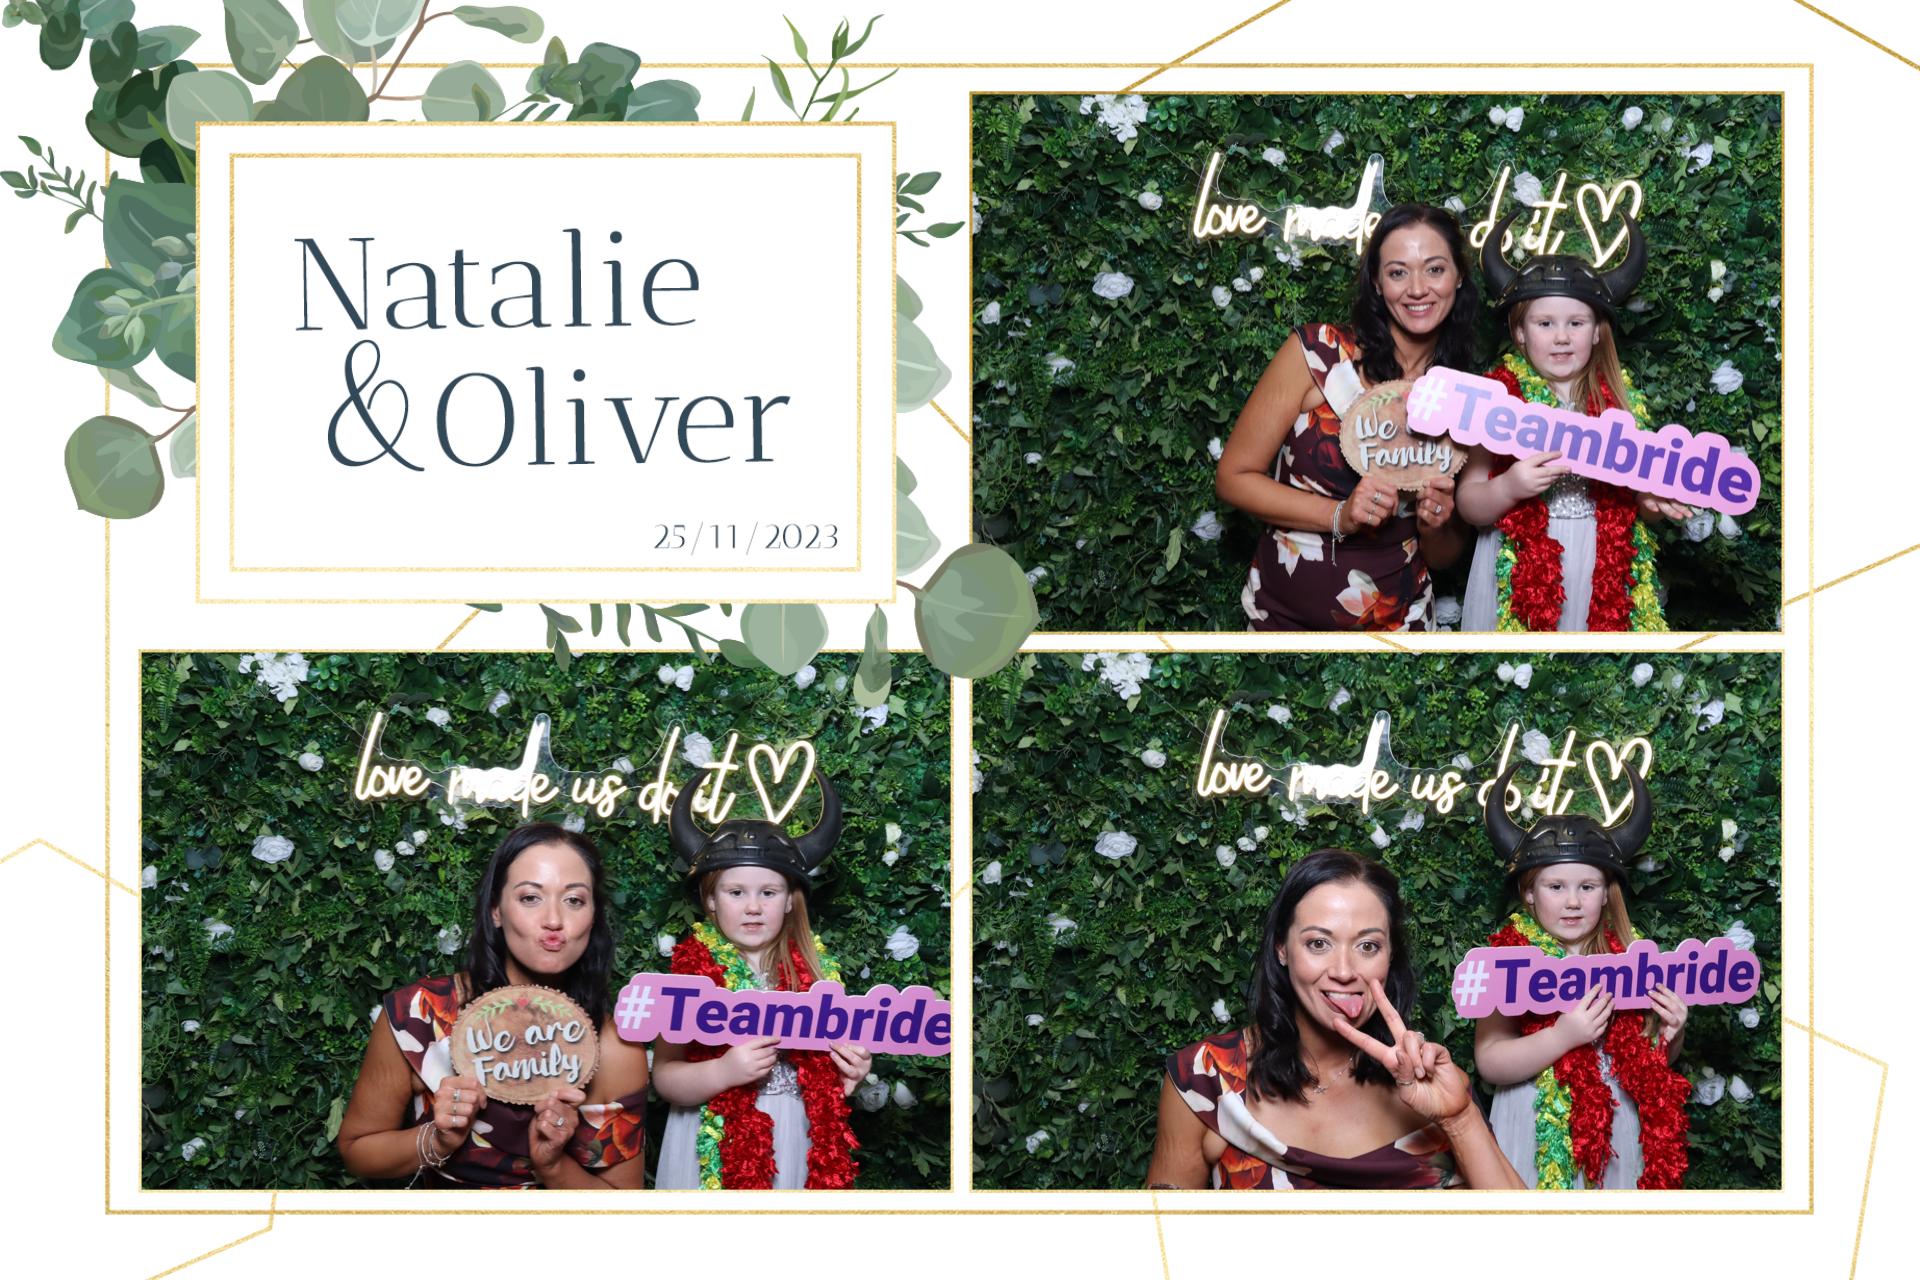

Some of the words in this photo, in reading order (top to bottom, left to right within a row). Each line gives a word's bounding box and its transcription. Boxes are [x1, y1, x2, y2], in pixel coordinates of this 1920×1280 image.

[1193, 152, 1267, 238] love
[1524, 172, 1568, 256] it
[1355, 407, 1398, 440] We
[1410, 376, 1753, 504] #Teambride
[1357, 438, 1454, 474] Family
[354, 711, 431, 800] love
[448, 721, 560, 819] made
[571, 772, 629, 819] us
[1199, 708, 1273, 797] love
[1288, 718, 1399, 815] made
[1411, 769, 1468, 815] us
[1532, 730, 1577, 816] it
[1455, 948, 1755, 1006] #Teambride
[466, 1017, 516, 1054] We
[525, 1020, 586, 1046] are
[617, 984, 952, 1046] #Teambride
[471, 1042, 583, 1087] Family
